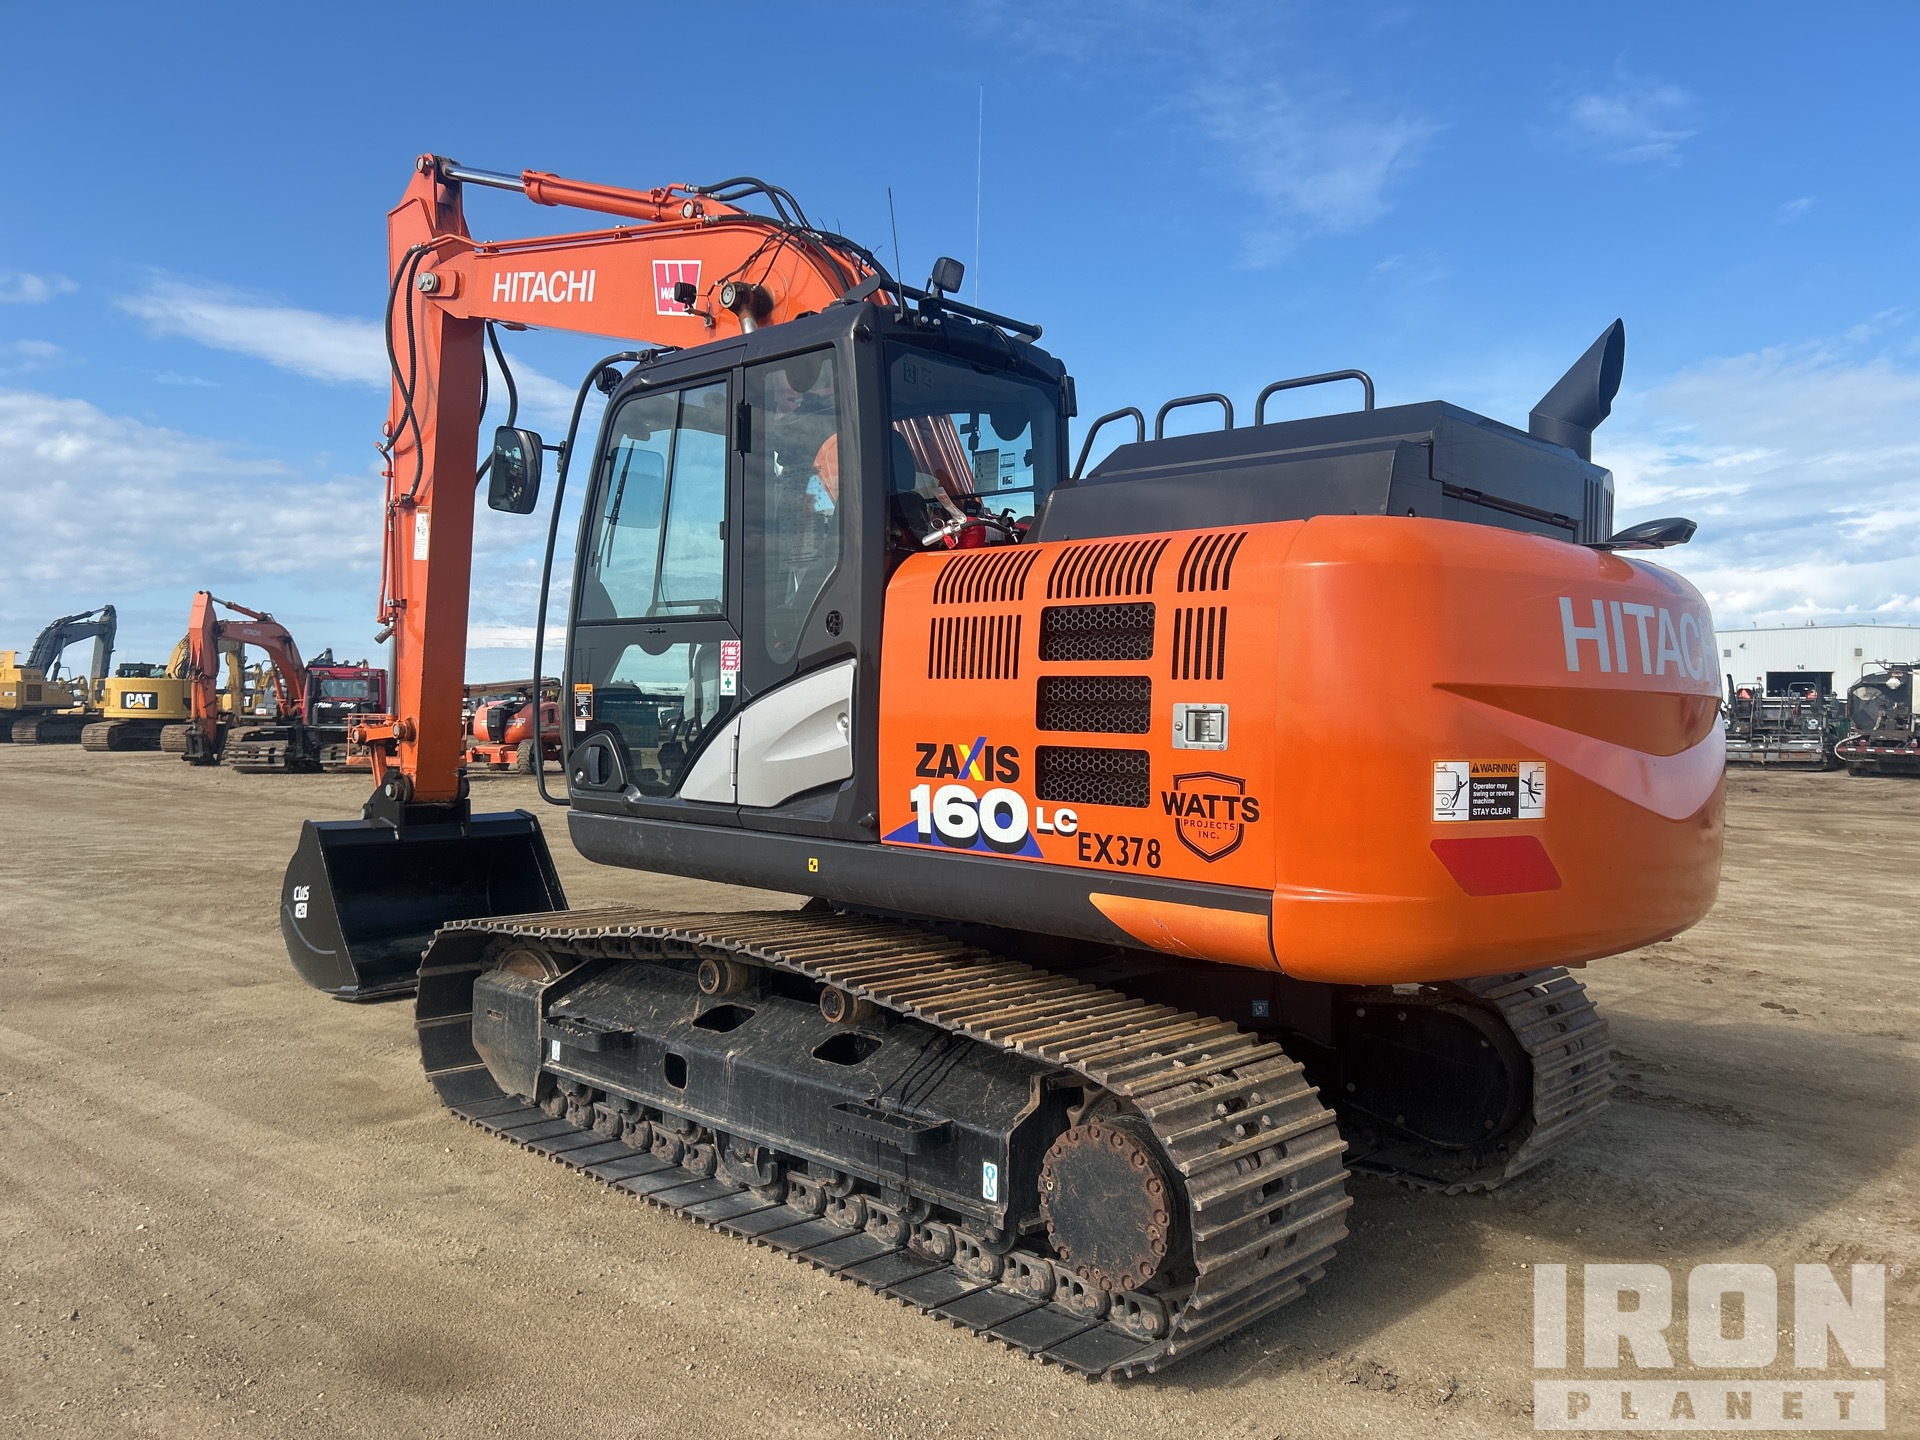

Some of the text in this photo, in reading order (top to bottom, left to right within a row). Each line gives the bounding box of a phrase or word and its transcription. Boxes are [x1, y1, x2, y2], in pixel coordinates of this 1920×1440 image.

[492, 270, 596, 303] HITACHI
[1559, 597, 1717, 681] HITACH
[126, 693, 152, 708] CAT
[916, 736, 1020, 784] ZAXIS
[1480, 764, 1517, 774] WARNING
[1472, 782, 1496, 791] Operator
[1472, 790, 1489, 798] swing
[1496, 789, 1515, 797] reverse
[1161, 791, 1260, 823] WATTS
[1472, 797, 1495, 805] machine
[910, 784, 1078, 850] 160 LC
[1472, 807, 1512, 816] STAY CLEAR
[1183, 819, 1236, 831] PROJECTS
[1198, 830, 1220, 840] INC.
[1078, 831, 1161, 869] EX378
